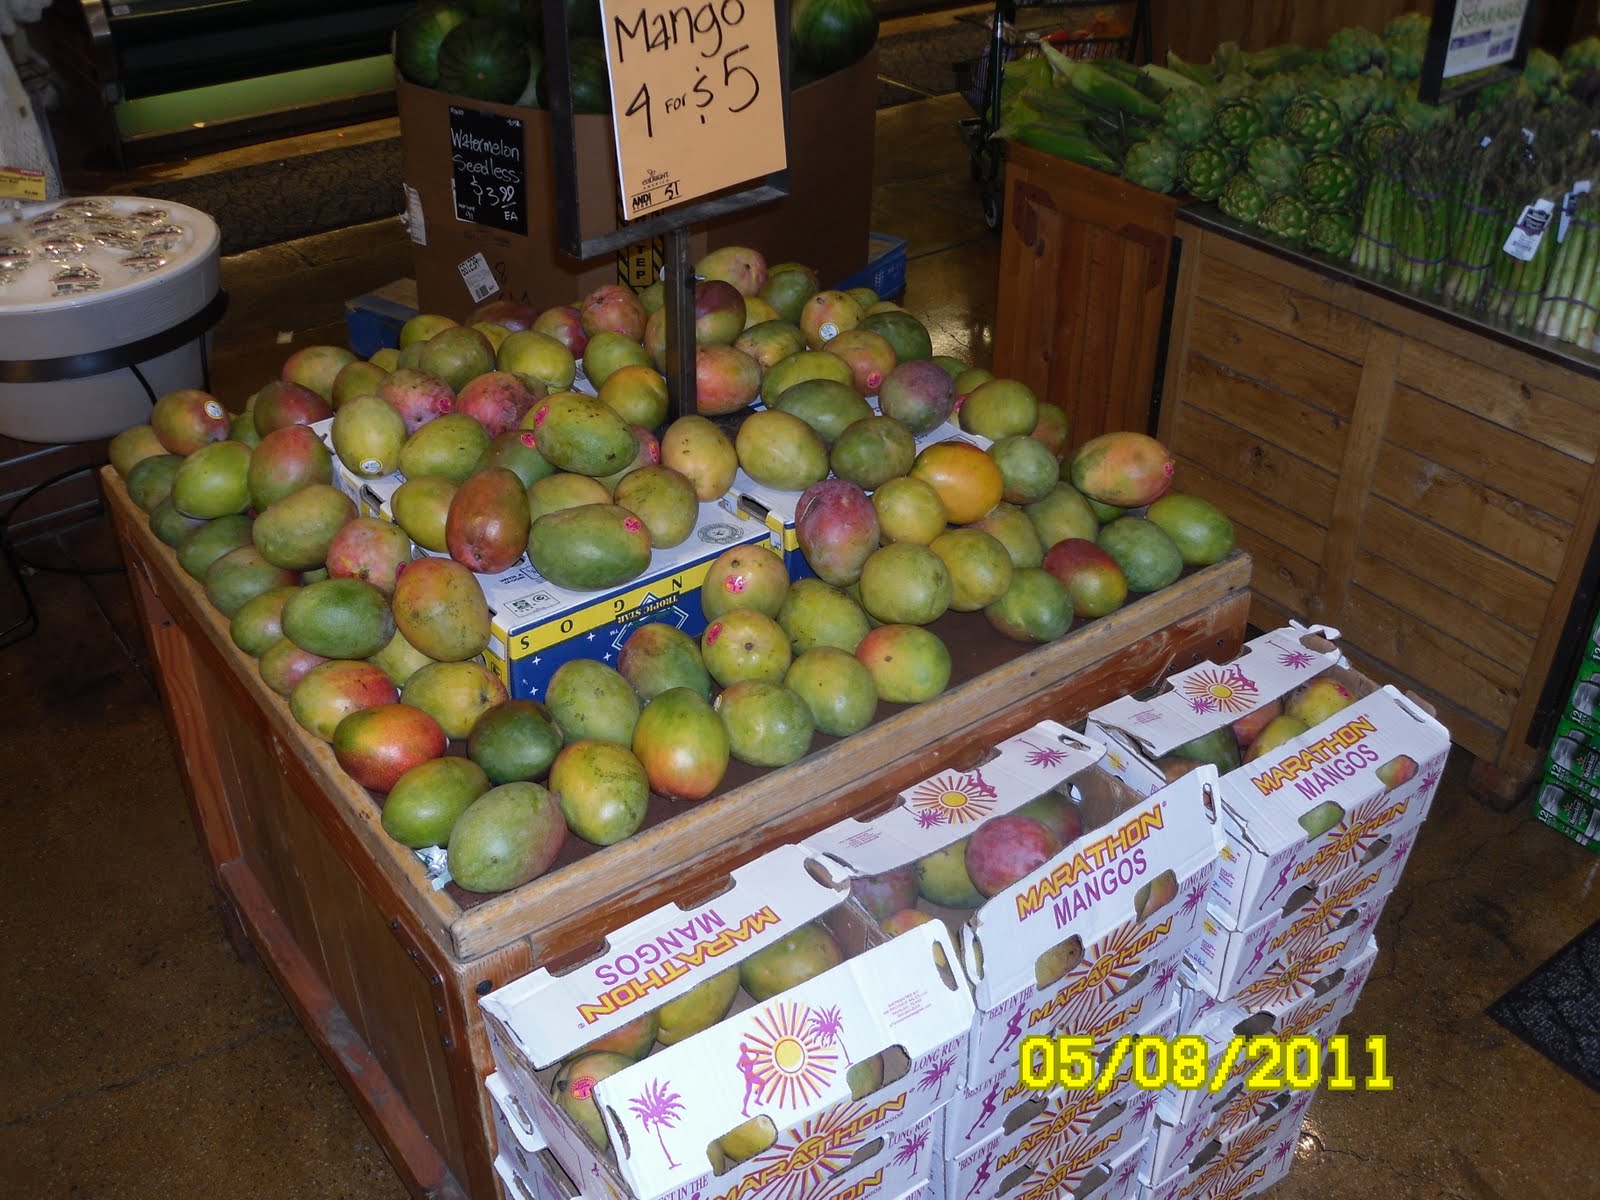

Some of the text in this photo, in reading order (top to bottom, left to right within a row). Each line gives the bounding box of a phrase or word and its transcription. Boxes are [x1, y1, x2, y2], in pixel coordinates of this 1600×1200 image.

[614, 0, 745, 63] Mango
[625, 83, 653, 138] 4
[450, 128, 520, 161] Watermelon
[452, 154, 520, 183] Seedless
[504, 211, 519, 221] EA
[643, 594, 680, 614] TROPIC
[1572, 710, 1582, 723] 12
[1250, 715, 1378, 797] MARATHON
[1294, 744, 1379, 801] MANGOS
[1551, 764, 1561, 777] 12
[1292, 797, 1411, 882] MARATHON
[1538, 810, 1549, 823] 12
[1015, 803, 1165, 922] MARATHON
[1052, 848, 1147, 930] MANGOS
[1267, 867, 1383, 954] MARATHON
[576, 905, 782, 1025] MARATHON
[595, 909, 727, 986] MANGOS
[1028, 915, 1174, 1028] MARATHON
[1233, 935, 1352, 998] ARATHON
[689, 1174, 709, 1195] THE
[912, 1049, 940, 1074] LONG
[711, 1092, 907, 1200] MARATHON
[873, 1111, 904, 1131] MANGOS
